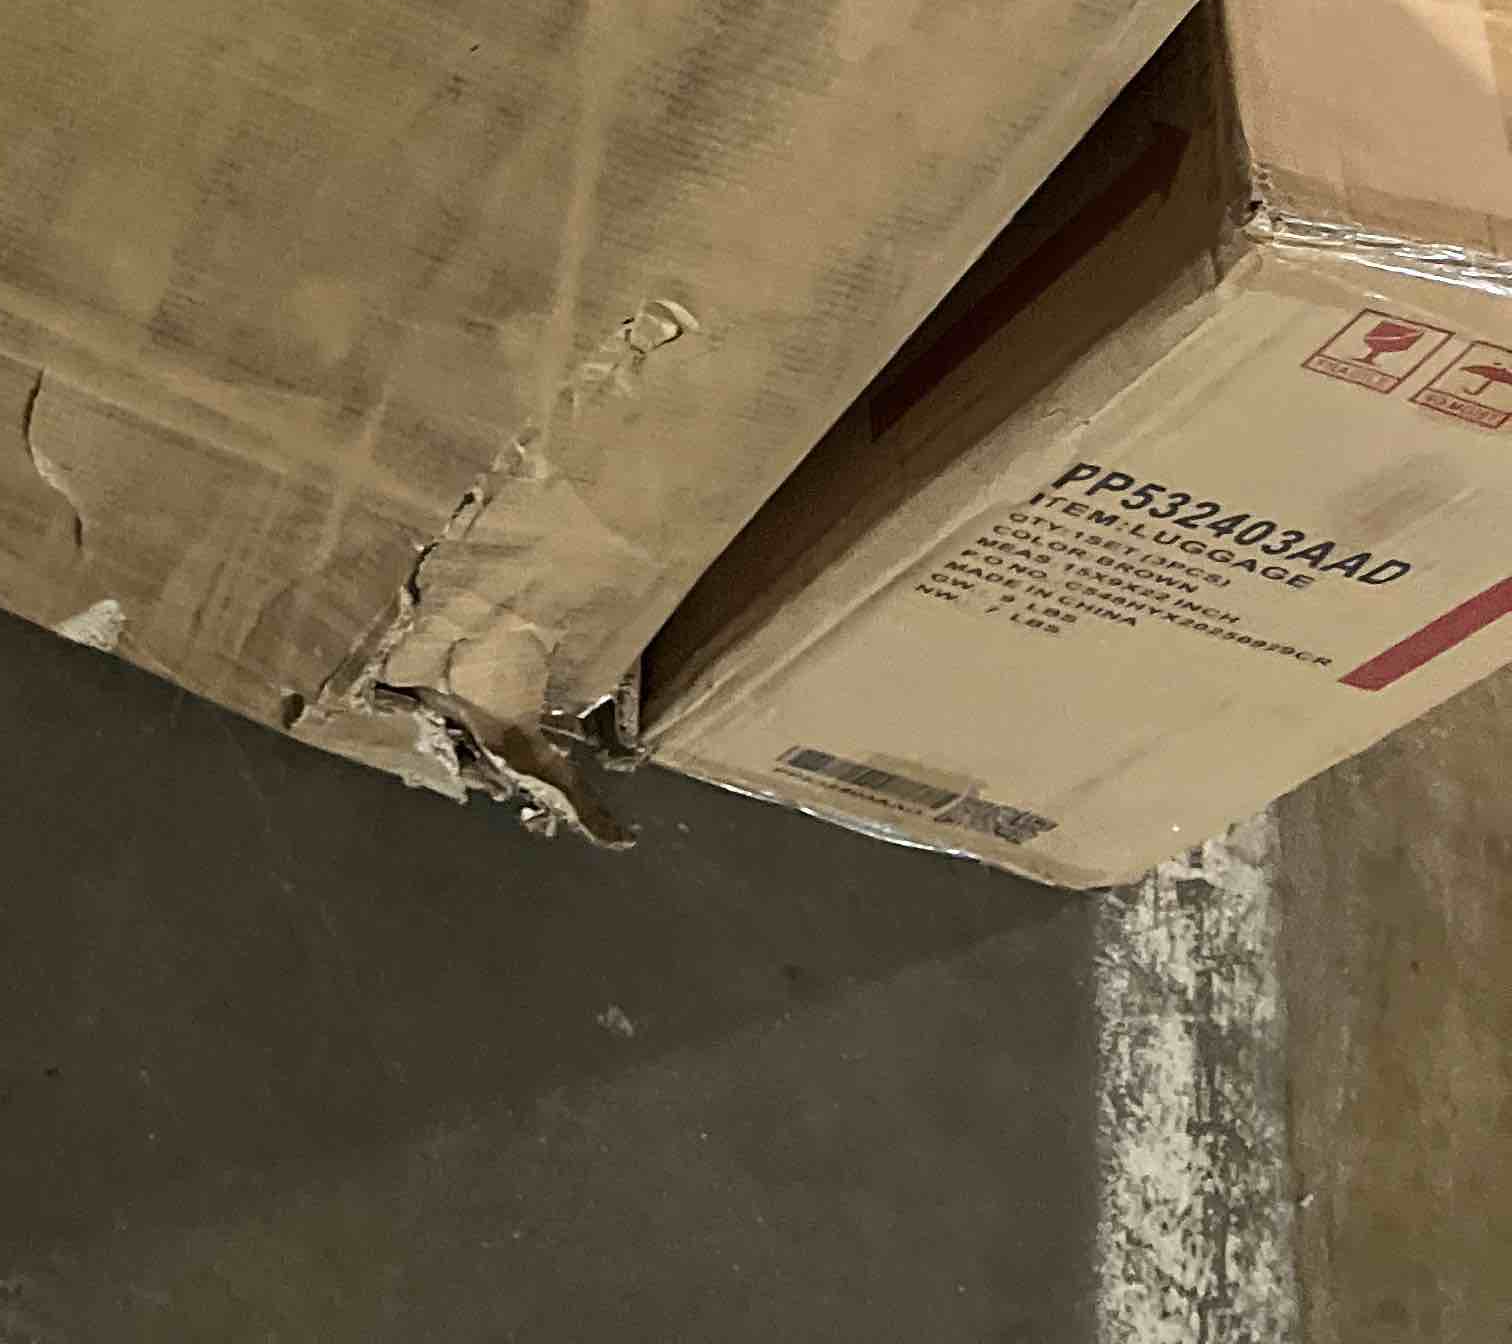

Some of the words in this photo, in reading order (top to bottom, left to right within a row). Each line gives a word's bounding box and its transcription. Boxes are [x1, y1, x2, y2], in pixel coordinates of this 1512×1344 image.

[1050, 462, 1411, 585] PP532403AAD
[944, 561, 1021, 589] MADE
[1025, 584, 1054, 599] IN
[1058, 595, 1137, 627] CHINA
[1096, 555, 1199, 593] BROWN
[1173, 598, 1241, 624] INCH
